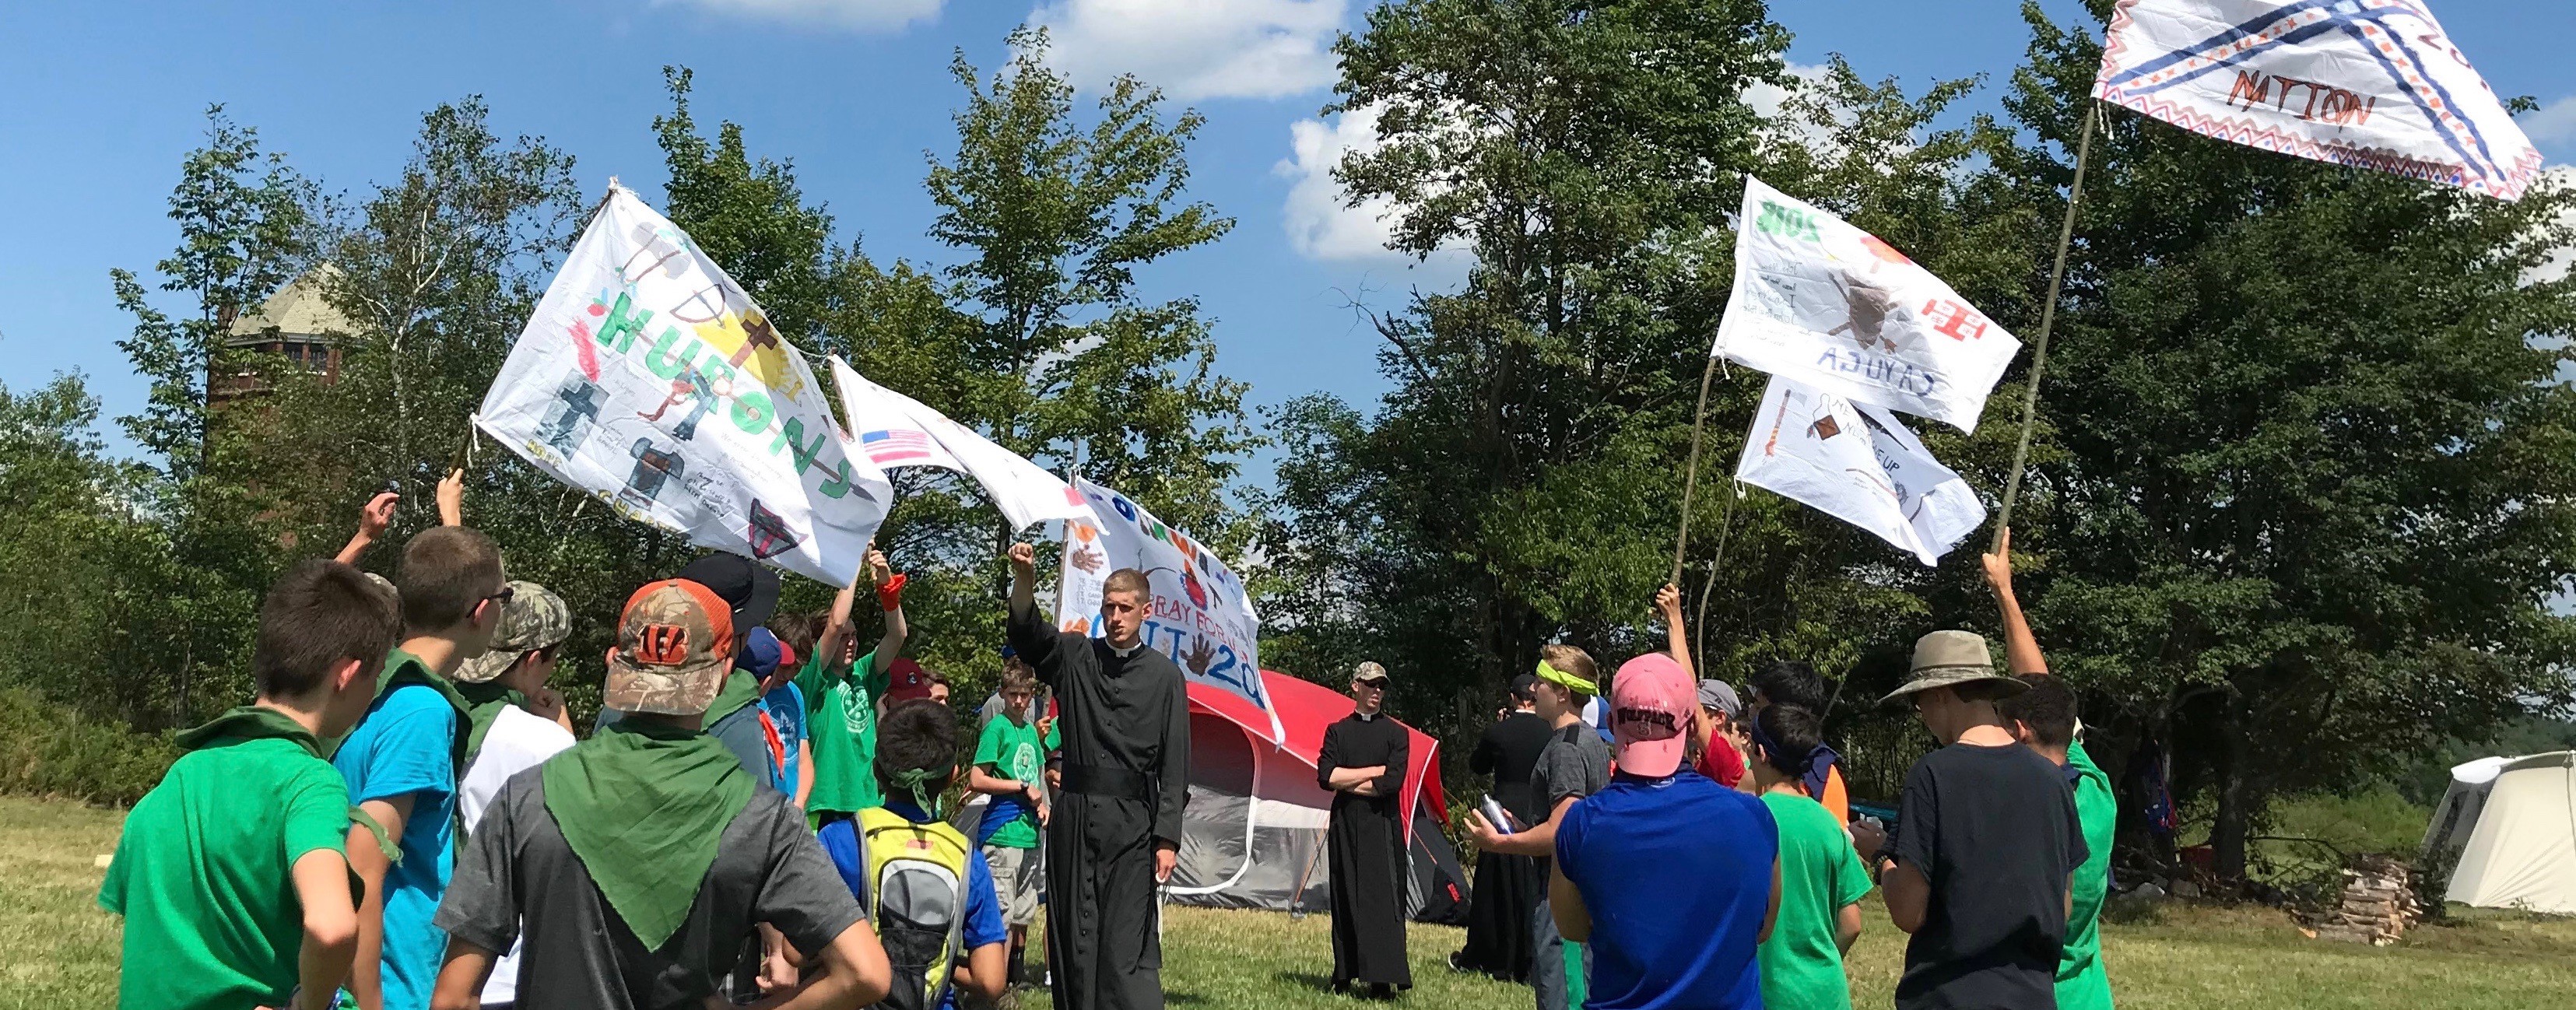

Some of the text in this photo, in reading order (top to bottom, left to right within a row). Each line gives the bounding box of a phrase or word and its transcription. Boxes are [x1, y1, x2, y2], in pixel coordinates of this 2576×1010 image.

[2227, 69, 2376, 132] NATION
[596, 290, 852, 500] HURONS
[1883, 455, 1900, 472] UP
